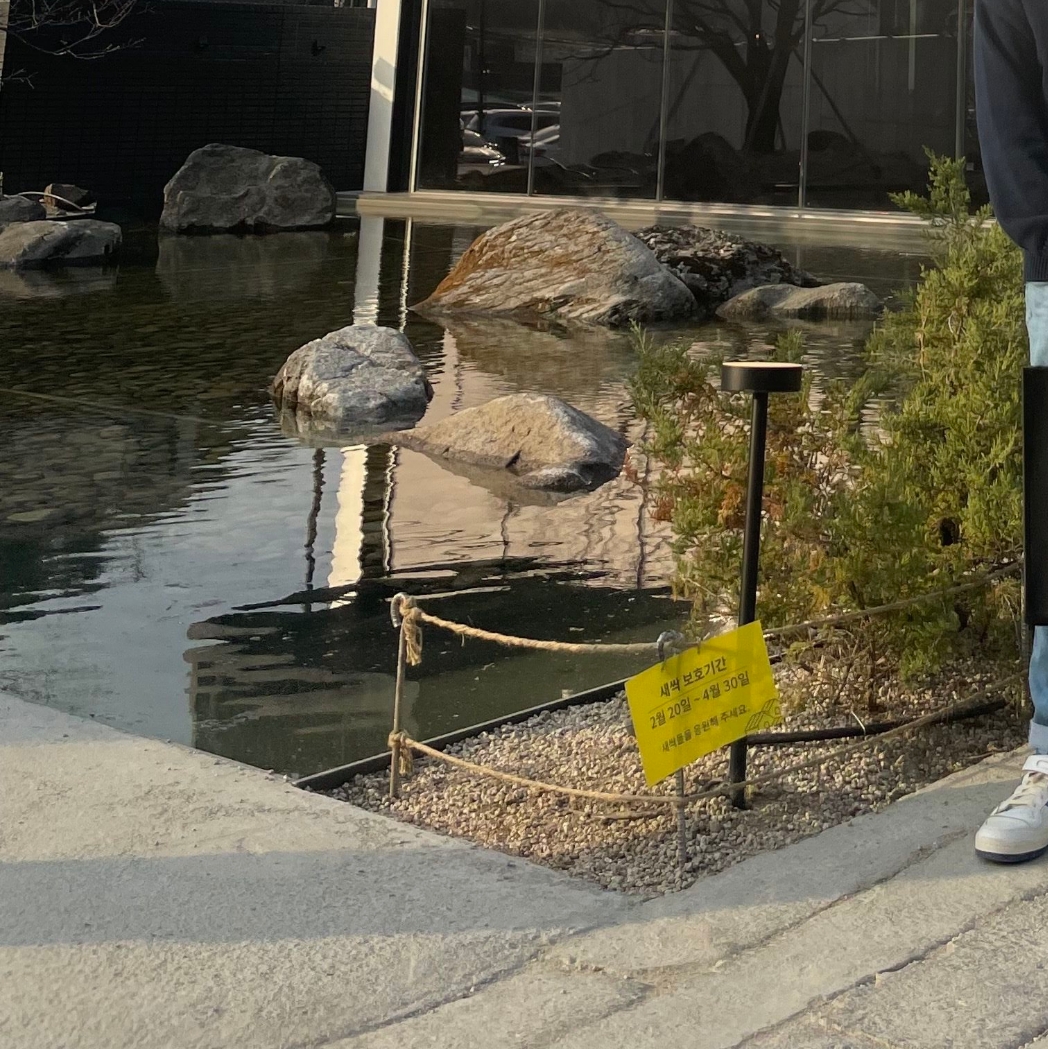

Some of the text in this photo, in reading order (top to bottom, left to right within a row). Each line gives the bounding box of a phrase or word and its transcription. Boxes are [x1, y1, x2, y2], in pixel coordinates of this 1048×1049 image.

[650, 710, 665, 729] 2월
[668, 697, 691, 718] 20일
[702, 683, 721, 700] 4월
[723, 671, 750, 692] 30일
[660, 656, 726, 698] 새싹 보호기간
